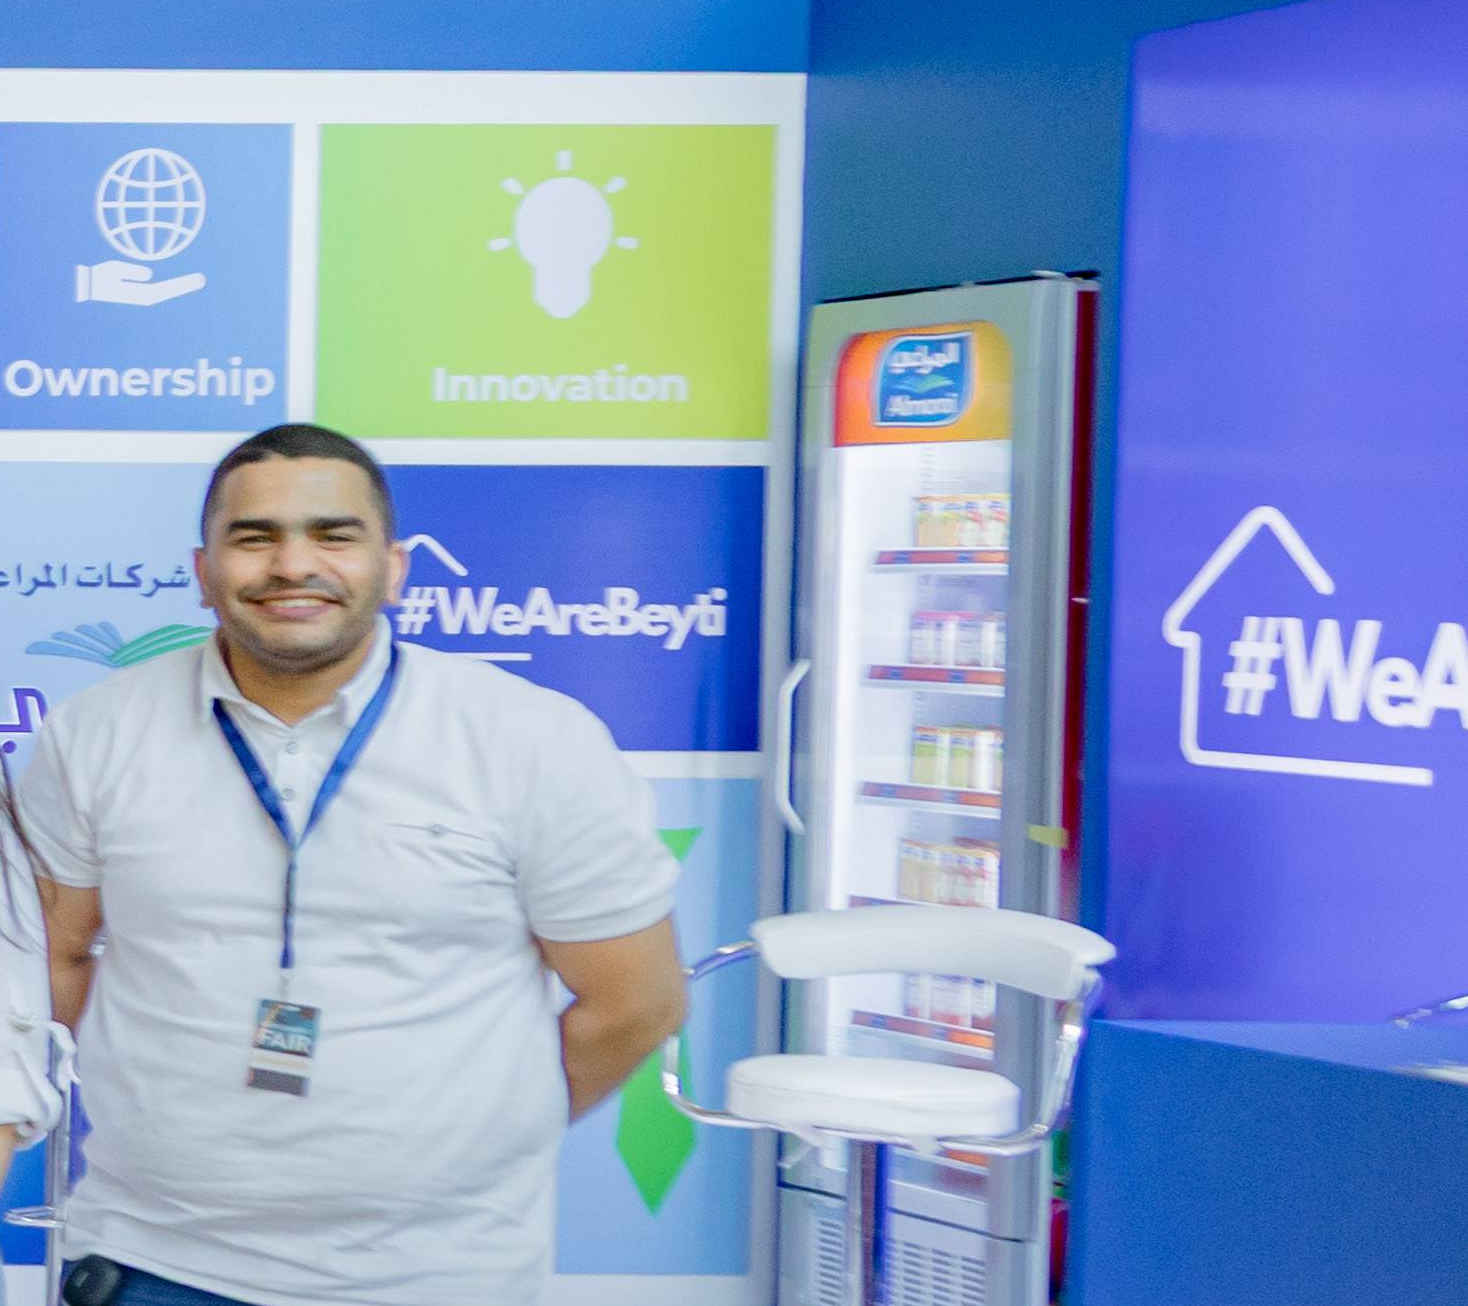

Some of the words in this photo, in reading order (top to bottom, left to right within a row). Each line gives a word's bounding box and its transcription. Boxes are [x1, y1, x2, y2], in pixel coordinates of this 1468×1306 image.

[3, 356, 276, 406] Ownership
[431, 363, 689, 402] Innovation
[74, 562, 191, 598] شركات
[395, 585, 728, 651] #WeAreBeyti
